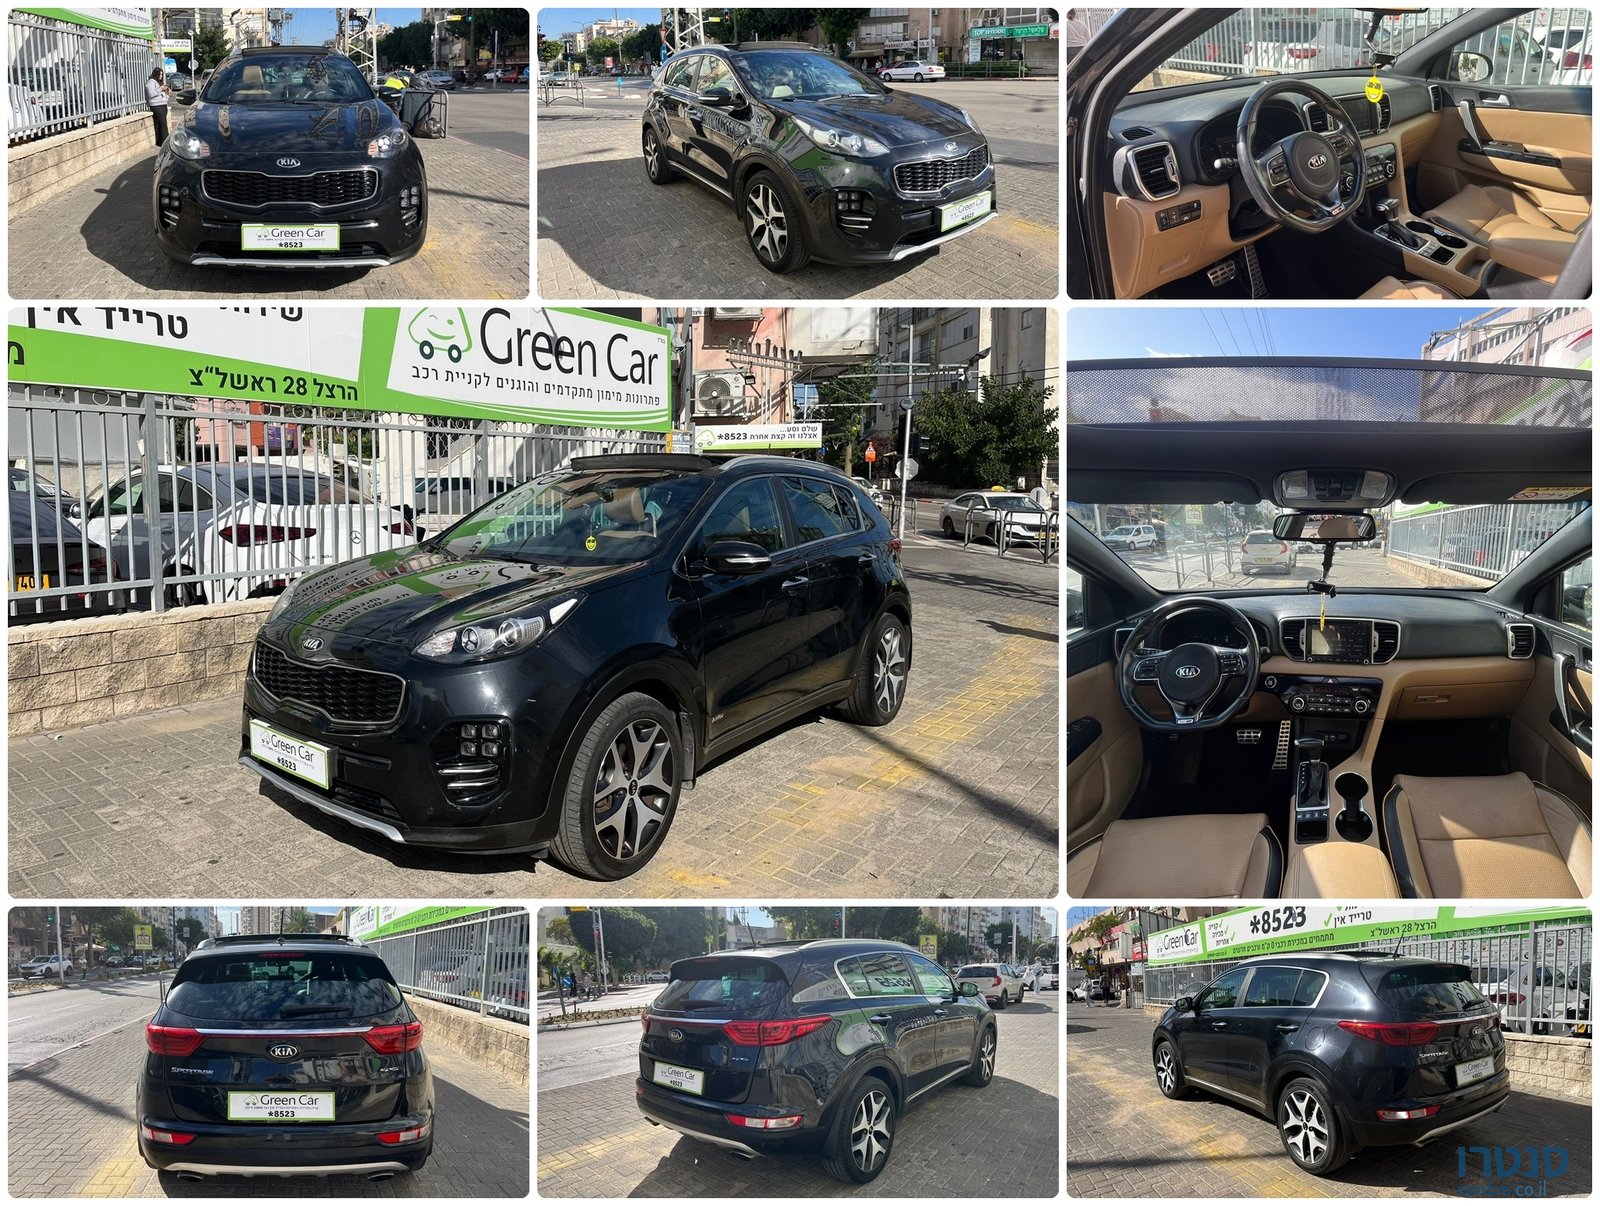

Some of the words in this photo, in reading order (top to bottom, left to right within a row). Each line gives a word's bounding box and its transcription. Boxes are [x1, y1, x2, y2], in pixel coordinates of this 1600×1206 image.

[1310, 154, 1327, 168] KIA
[957, 202, 976, 214] Green
[975, 197, 985, 207] Car
[271, 228, 304, 238] Green
[306, 228, 325, 238] Car
[95, 306, 188, 339] טרייד
[480, 307, 597, 378] Green
[607, 333, 658, 386] Car
[411, 366, 438, 381] רכב
[445, 370, 490, 389] לקניית
[283, 376, 308, 396] 28
[313, 378, 358, 401] הרצל
[496, 377, 539, 392] והוגנים
[544, 383, 593, 399] מתקדמים
[597, 389, 622, 402] מימון
[625, 393, 660, 406] פתרונות
[771, 433, 786, 441] קצת
[1179, 668, 1196, 676] KIA
[271, 734, 297, 756] Green
[298, 745, 314, 762] Car
[1334, 915, 1346, 928] אין
[1348, 910, 1372, 924] טרייד
[1402, 923, 1413, 933] 28
[1414, 921, 1437, 932] הרצל
[1163, 933, 1184, 951] Green
[1184, 928, 1199, 946] Car
[1308, 933, 1335, 944] מתמחים
[274, 1047, 294, 1057] KIA
[1467, 1063, 1481, 1072] Green
[1481, 1059, 1489, 1068] Car
[667, 1066, 684, 1078] Green
[684, 1071, 695, 1081] Car
[260, 1094, 296, 1106] Green
[298, 1094, 319, 1106] Car
